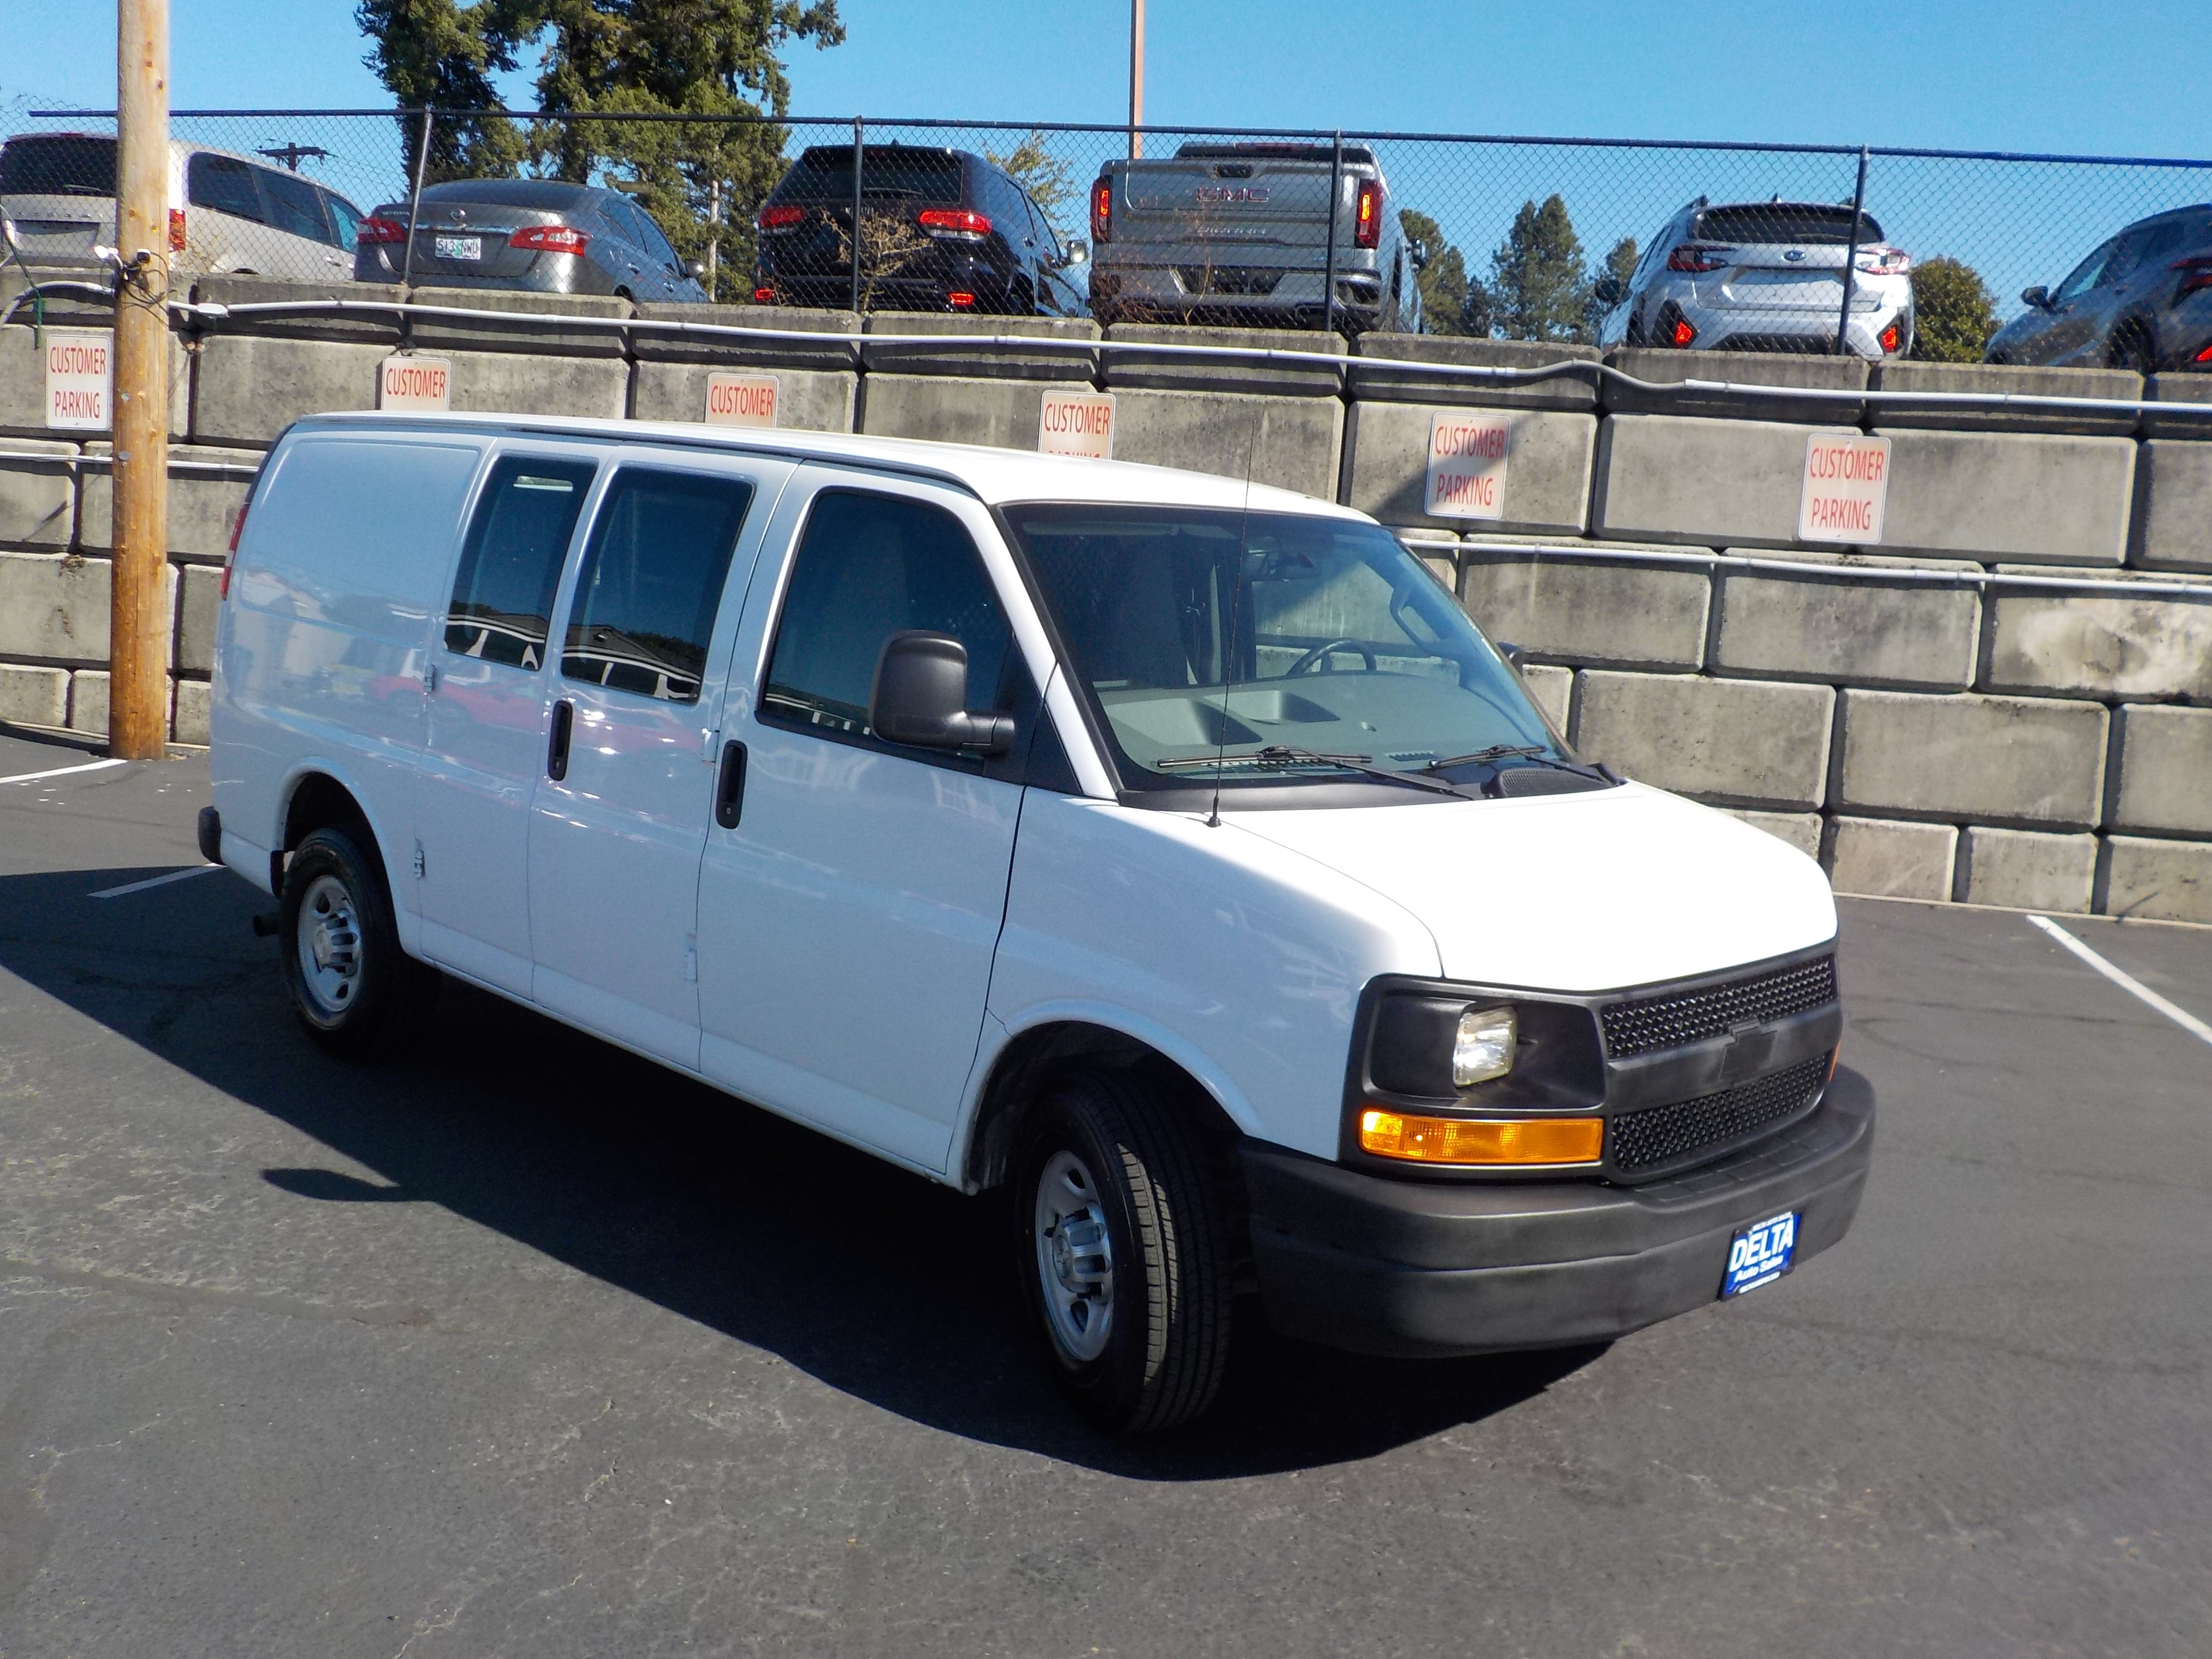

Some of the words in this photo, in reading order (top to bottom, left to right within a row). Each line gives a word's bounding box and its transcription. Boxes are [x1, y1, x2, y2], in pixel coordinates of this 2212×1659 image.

[1196, 187, 1270, 203] GMC
[50, 346, 106, 375] CUSTOMER
[386, 367, 446, 398] CUSTOMER
[55, 390, 100, 419] PARKING
[710, 384, 774, 416] CUSTOMER
[1044, 403, 1110, 435] CUSTOMER
[1435, 425, 1505, 458] CUSTOMER
[1810, 447, 1884, 481] CUSTOMER
[1436, 473, 1493, 506] PARKING
[1811, 498, 1872, 531] PARKING
[1729, 1219, 1794, 1272] DELTA
[1733, 1266, 1759, 1283] Auto
